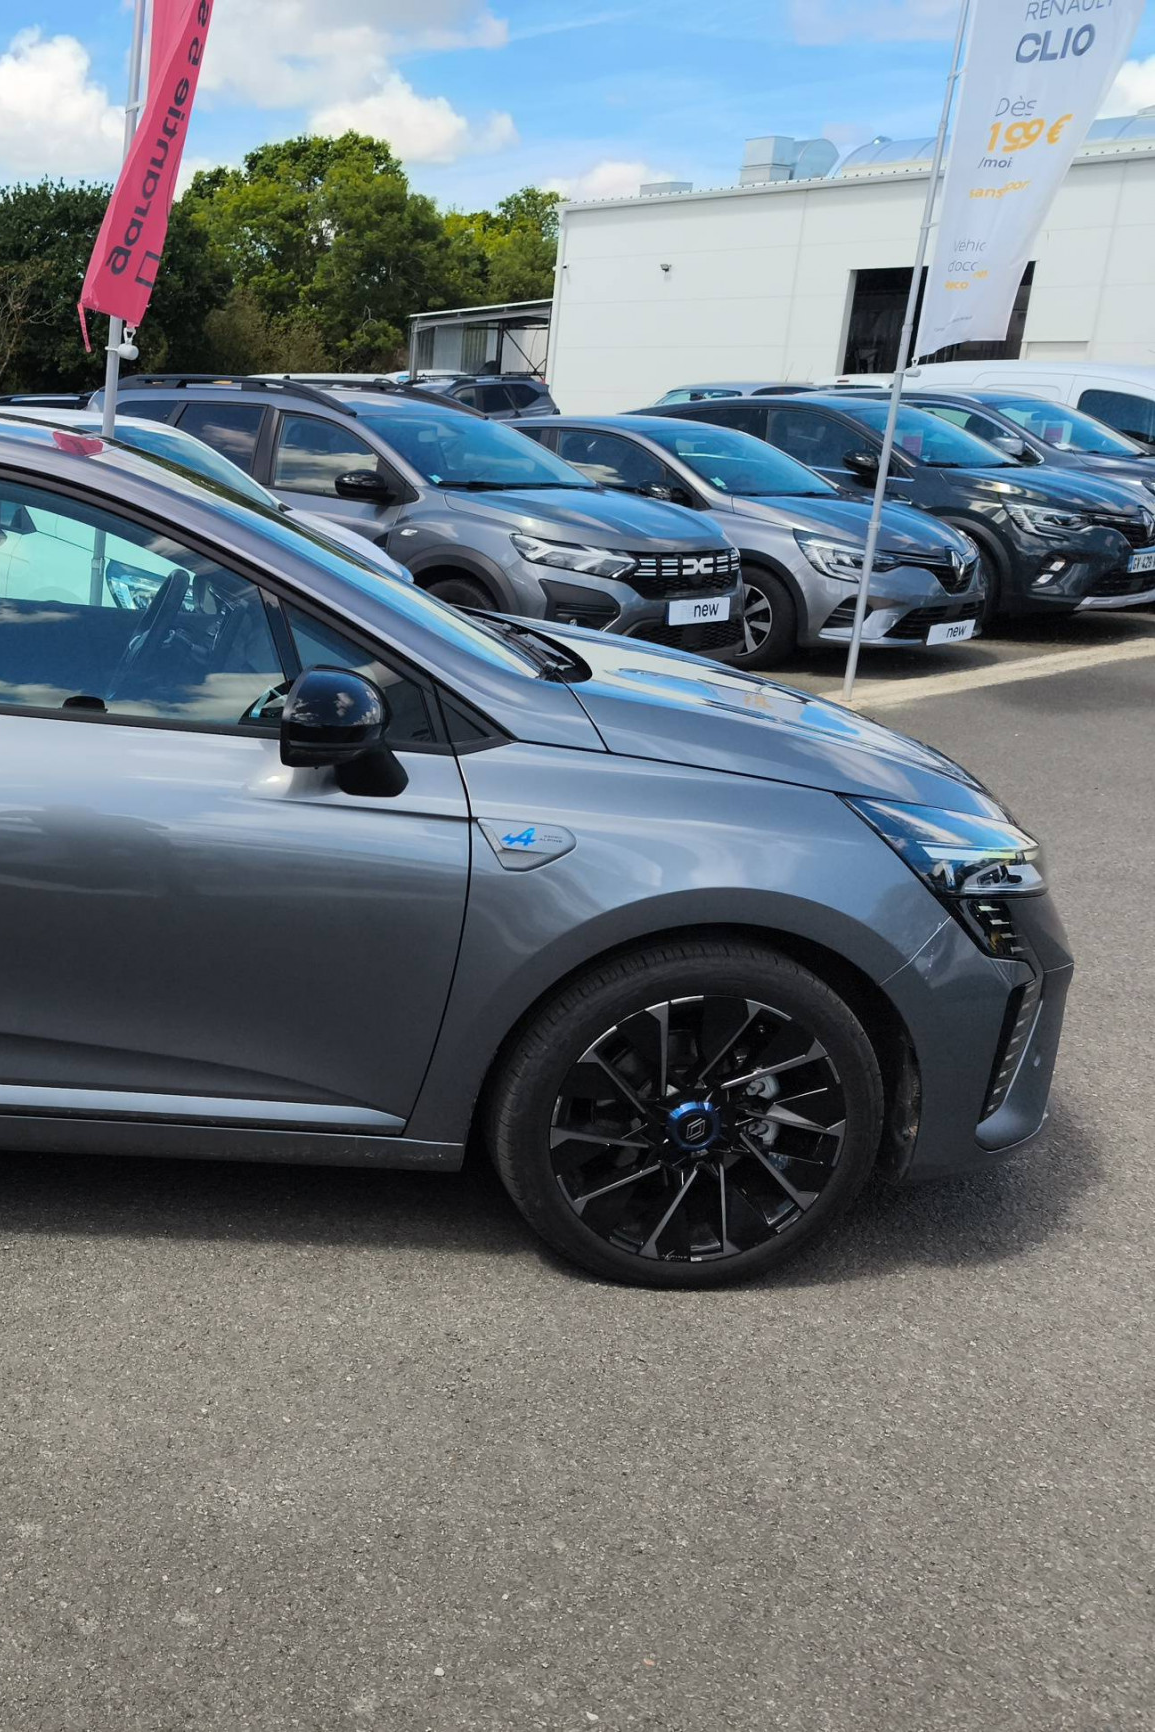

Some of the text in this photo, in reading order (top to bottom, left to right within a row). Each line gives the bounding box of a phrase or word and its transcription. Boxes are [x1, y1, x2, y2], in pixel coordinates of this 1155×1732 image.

[1015, 24, 1095, 64] CLIO
[994, 95, 1038, 117] Dès
[693, 603, 719, 618] new
[946, 626, 967, 638] new
